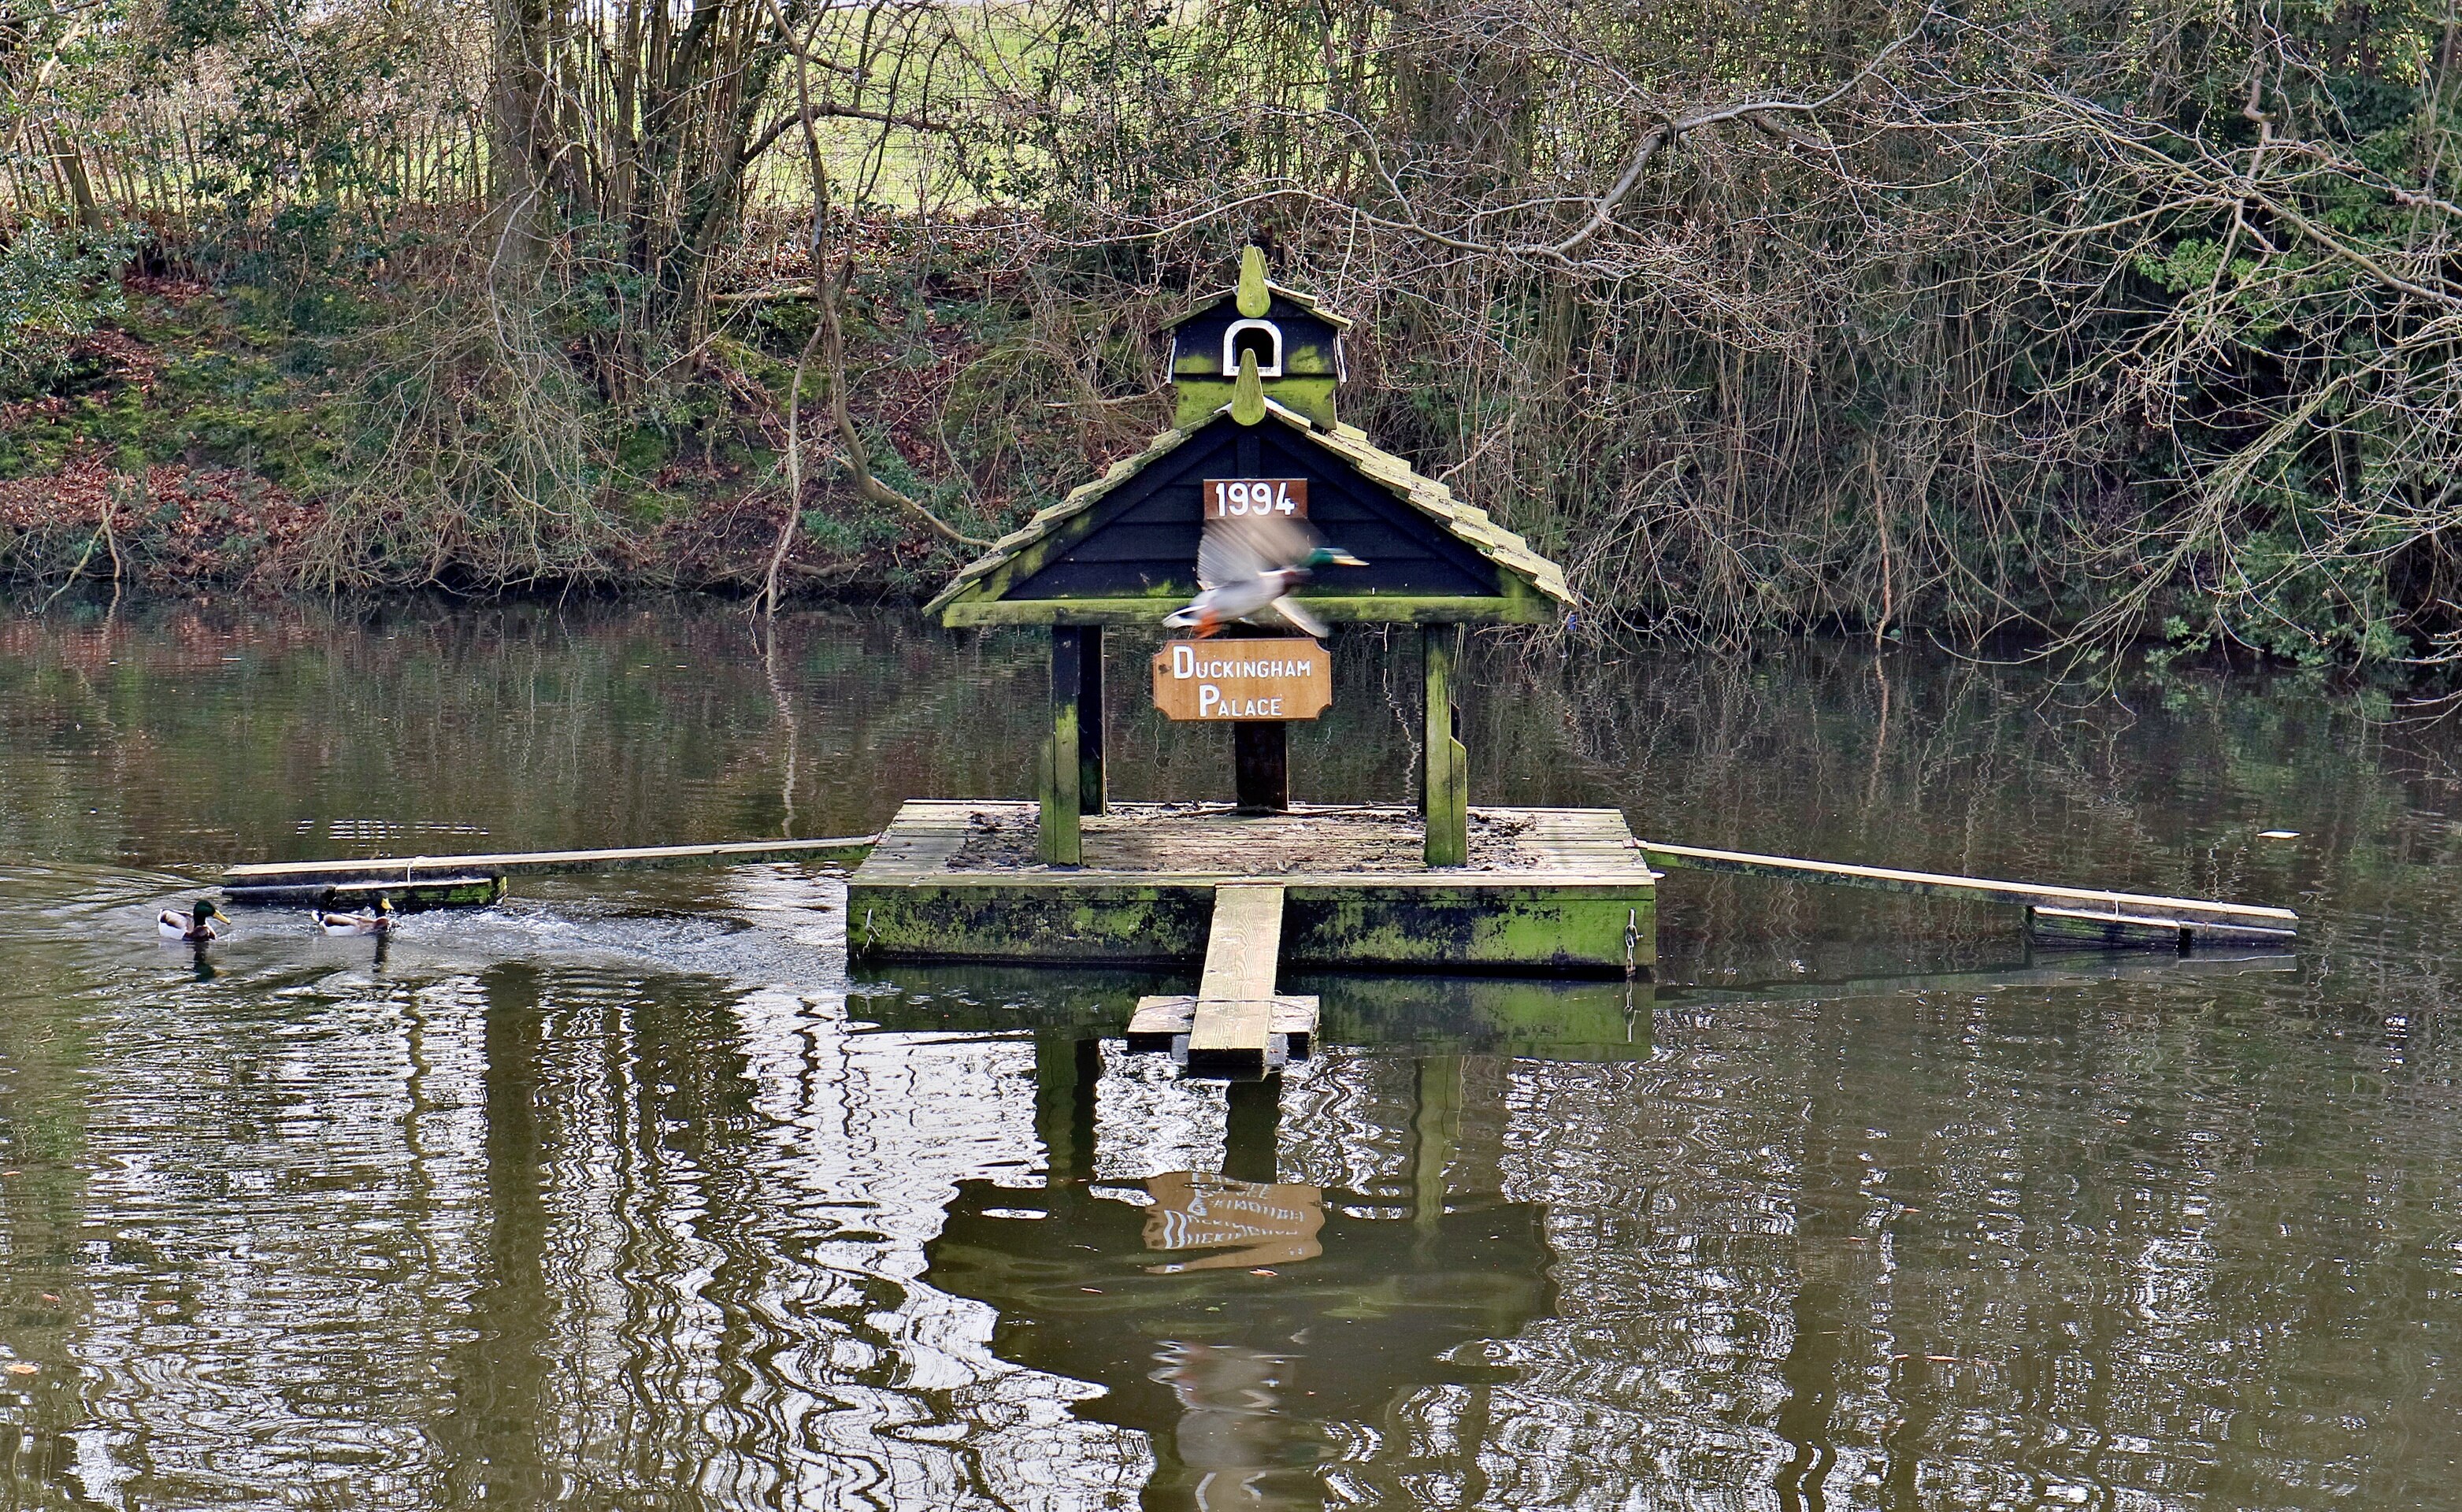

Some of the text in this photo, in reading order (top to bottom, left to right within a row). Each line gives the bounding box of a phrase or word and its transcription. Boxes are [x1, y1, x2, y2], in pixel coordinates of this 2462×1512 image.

[1215, 481, 1295, 517] 1994
[1173, 645, 1311, 679] DUCKINGHAM
[1199, 684, 1282, 717] PALACE
